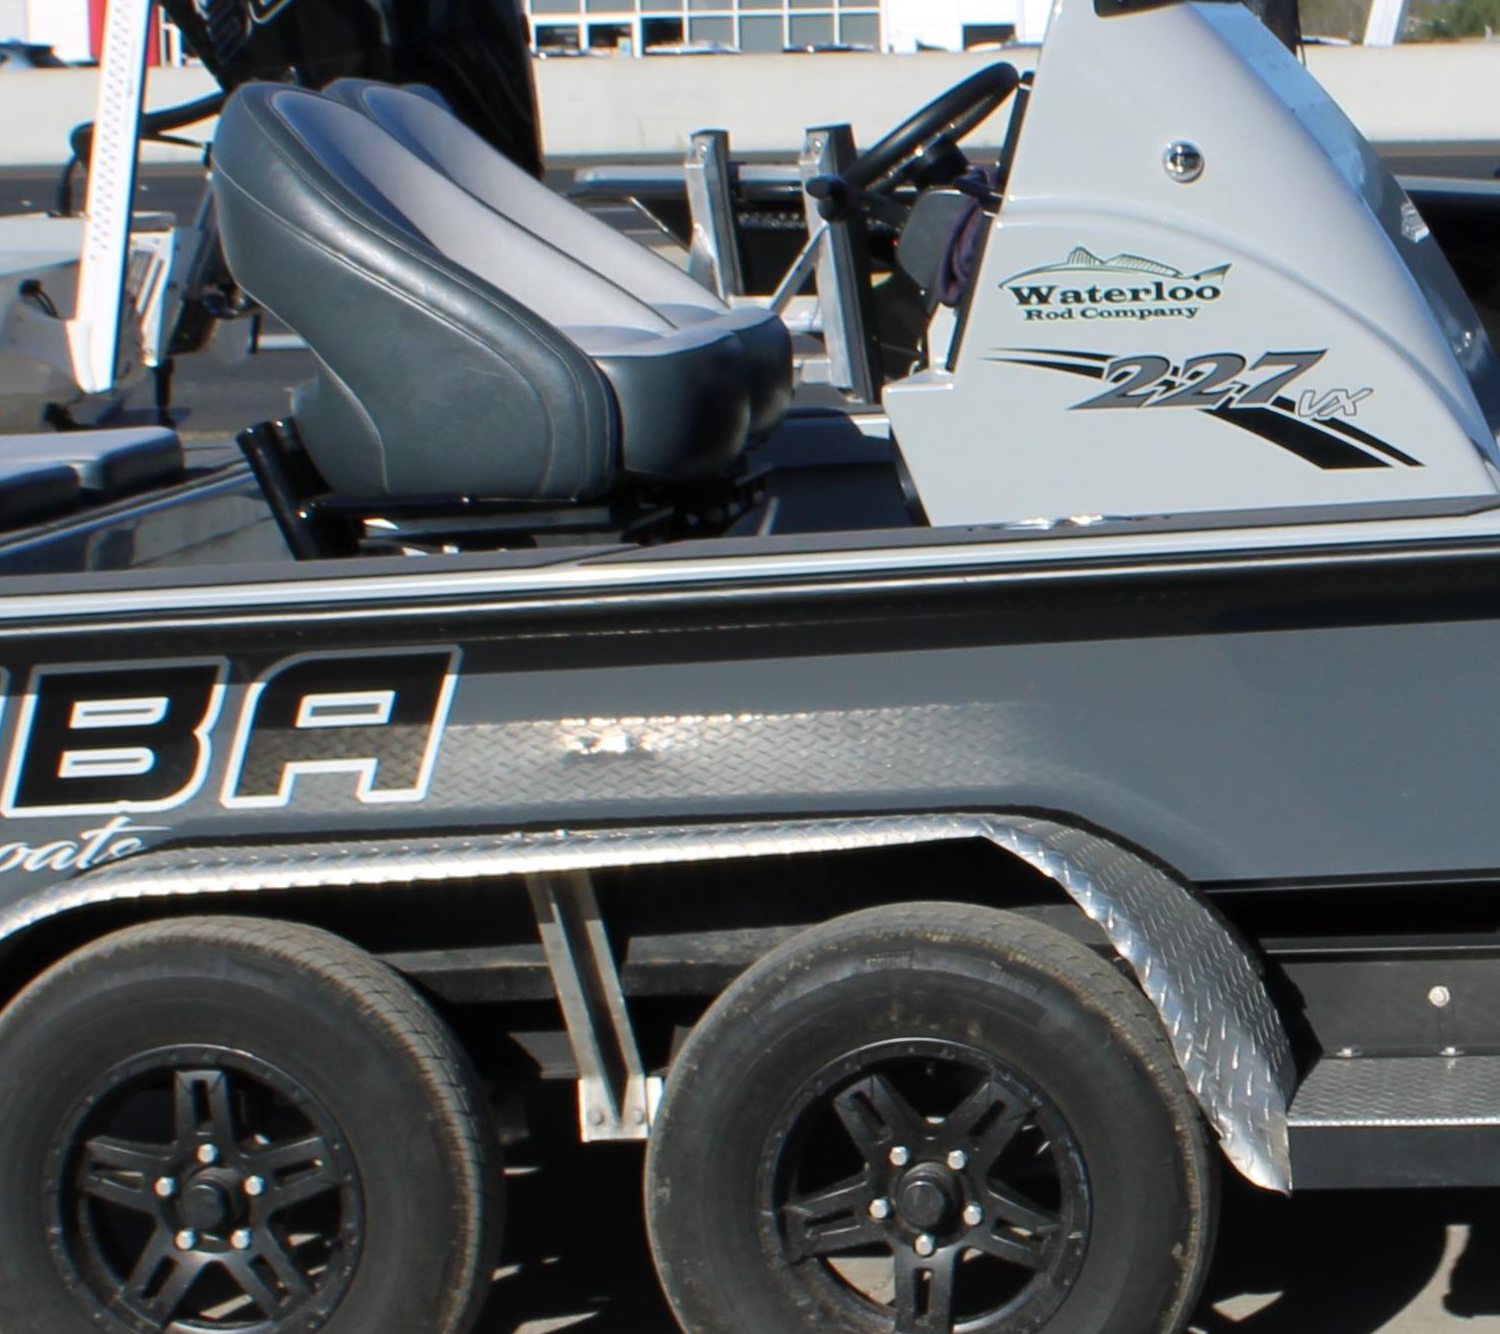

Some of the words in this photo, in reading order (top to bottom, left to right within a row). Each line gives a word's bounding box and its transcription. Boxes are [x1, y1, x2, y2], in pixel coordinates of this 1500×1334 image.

[1008, 281, 1222, 306] Waterloo
[1023, 307, 1074, 322] Rod
[1079, 305, 1201, 322] Company
[1064, 348, 1330, 410] 227
[1296, 386, 1374, 420] VX
